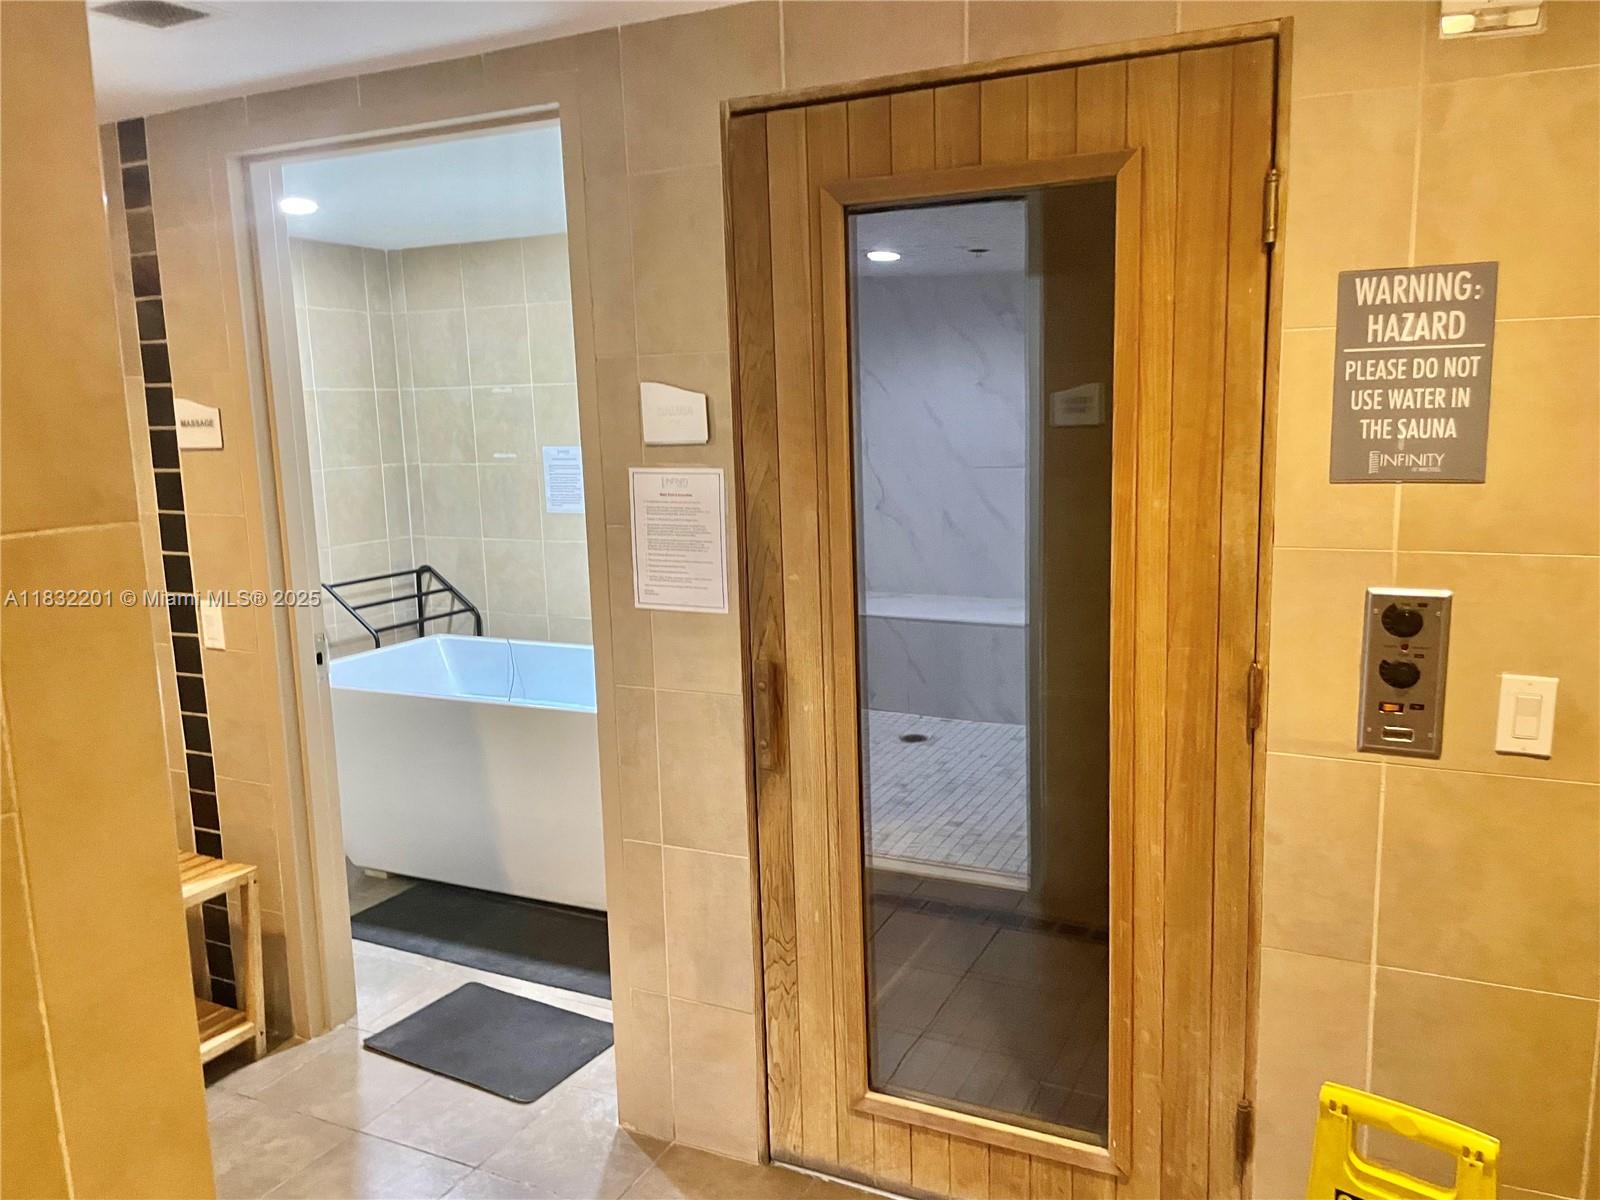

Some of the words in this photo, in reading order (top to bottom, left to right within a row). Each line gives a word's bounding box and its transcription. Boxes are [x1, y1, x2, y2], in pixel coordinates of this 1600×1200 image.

[1355, 270, 1482, 306] WARNING:
[1367, 310, 1466, 343] HAZARD
[1345, 358, 1408, 381] PLEASE
[1412, 357, 1439, 379] DO
[1444, 356, 1481, 378] NOT
[1350, 389, 1383, 411] USE
[1388, 387, 1446, 410] WATER
[1451, 387, 1471, 408] IN
[1359, 418, 1393, 440] THE
[1397, 417, 1457, 440] SAUNA
[1379, 451, 1446, 467] INFINITY
